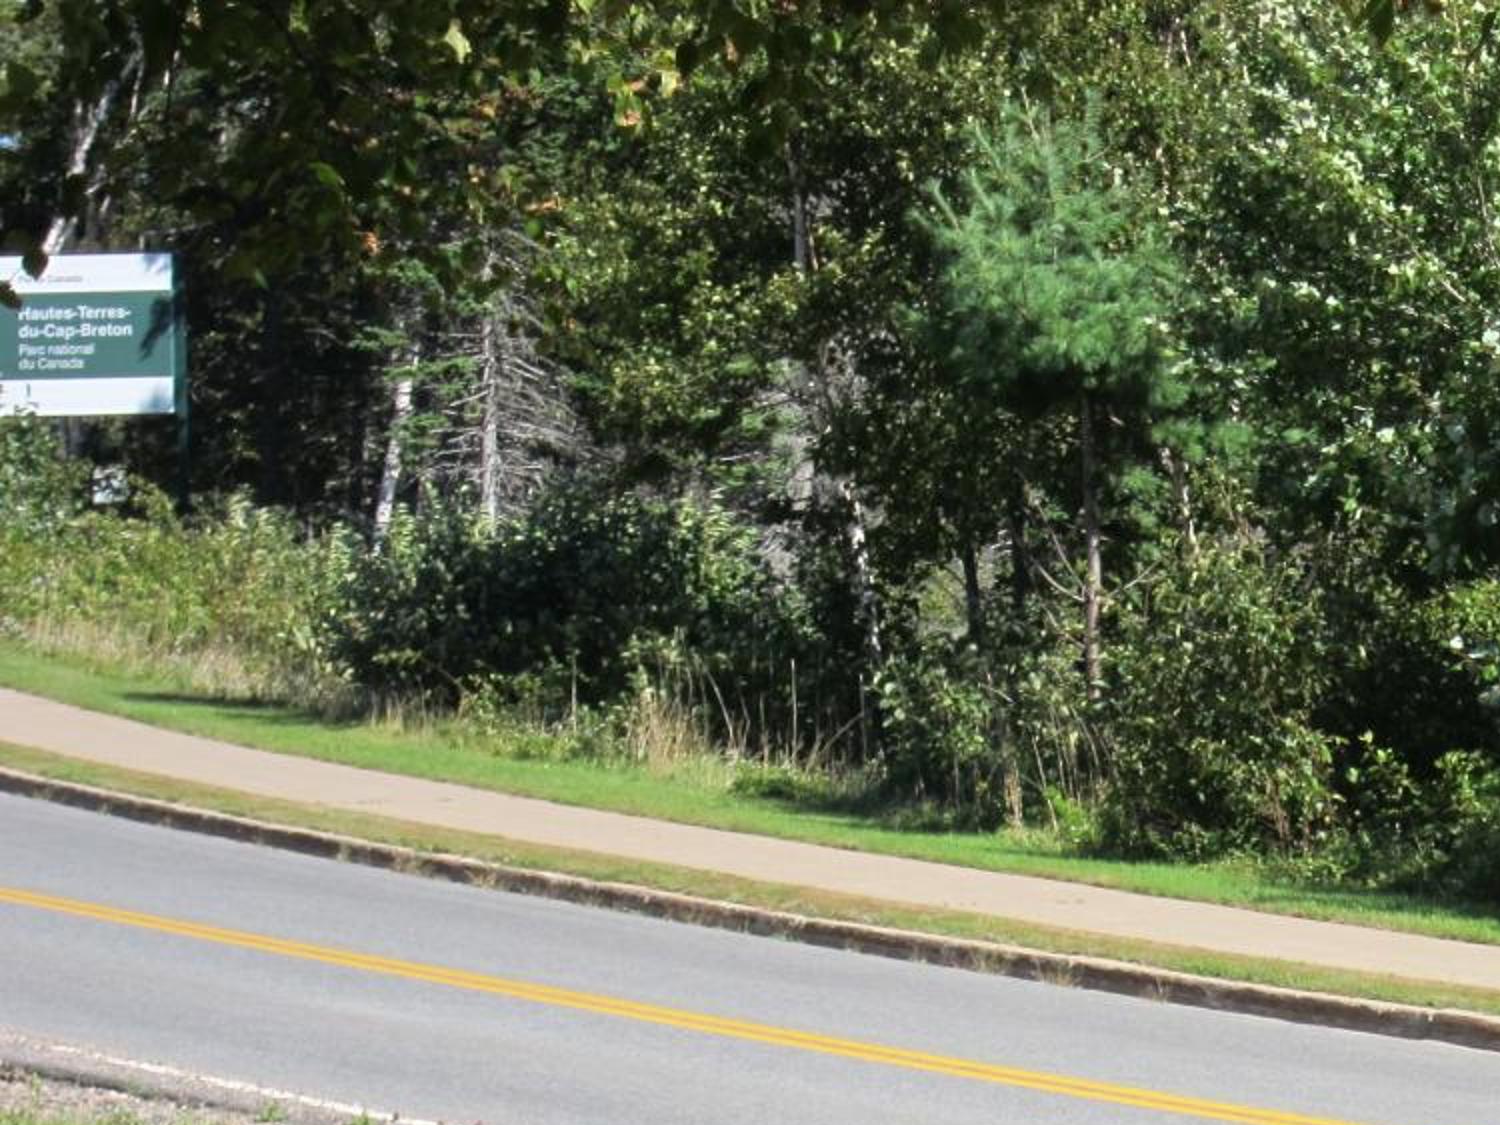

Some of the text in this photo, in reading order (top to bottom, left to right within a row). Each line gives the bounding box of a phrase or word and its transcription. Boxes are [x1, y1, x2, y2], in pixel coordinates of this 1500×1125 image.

[18, 305, 132, 321] Hautes-Terres-
[18, 323, 133, 340] du-Cap-Breton
[18, 342, 95, 356] Parc national
[18, 357, 84, 370] du Canada
